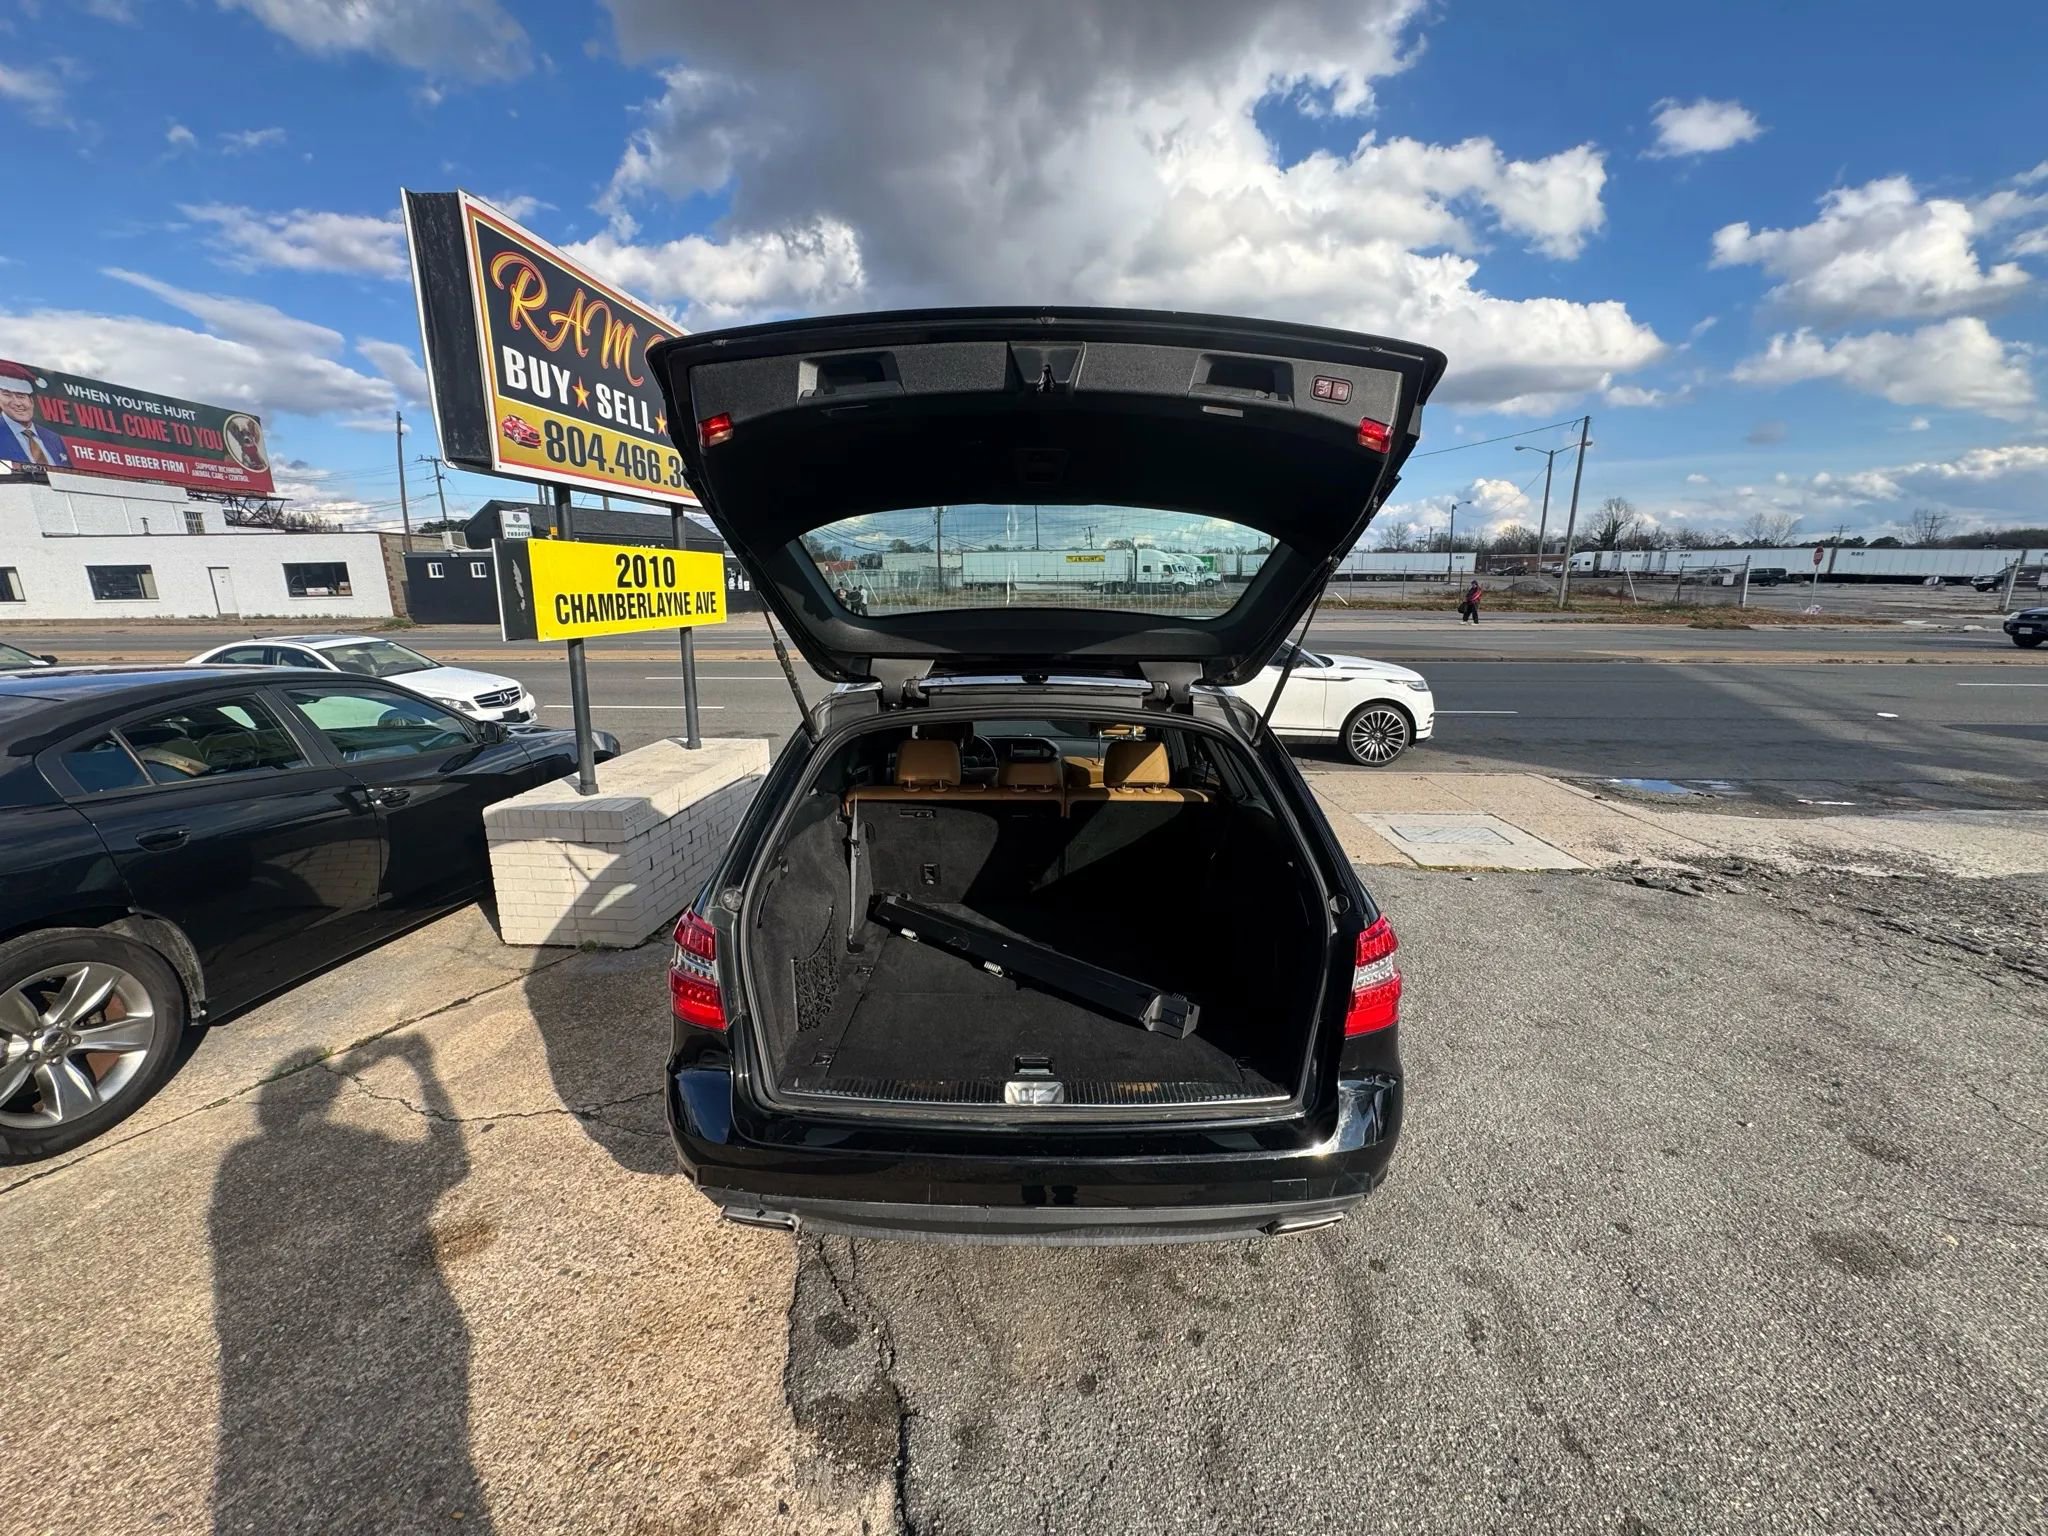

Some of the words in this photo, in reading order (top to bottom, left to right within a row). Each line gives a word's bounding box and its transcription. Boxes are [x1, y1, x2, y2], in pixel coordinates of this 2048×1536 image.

[490, 251, 665, 387] RAM
[63, 382, 111, 405] WHEN
[112, 394, 162, 415] YOU'RE
[163, 405, 196, 421] HURT
[502, 345, 571, 405] BUY
[595, 382, 655, 435] SELL
[37, 395, 73, 425] WE
[74, 402, 121, 434] WILL
[122, 413, 169, 442] COME
[170, 421, 192, 447] TO
[195, 427, 224, 451] YOU
[72, 445, 96, 461] THE
[98, 449, 124, 465] JOEL
[125, 454, 160, 471] BIEBER
[161, 459, 184, 474] FIRM
[615, 553, 676, 589] 2010
[555, 591, 692, 625] CHAMBERLAYNE
[695, 591, 717, 615] AVE
